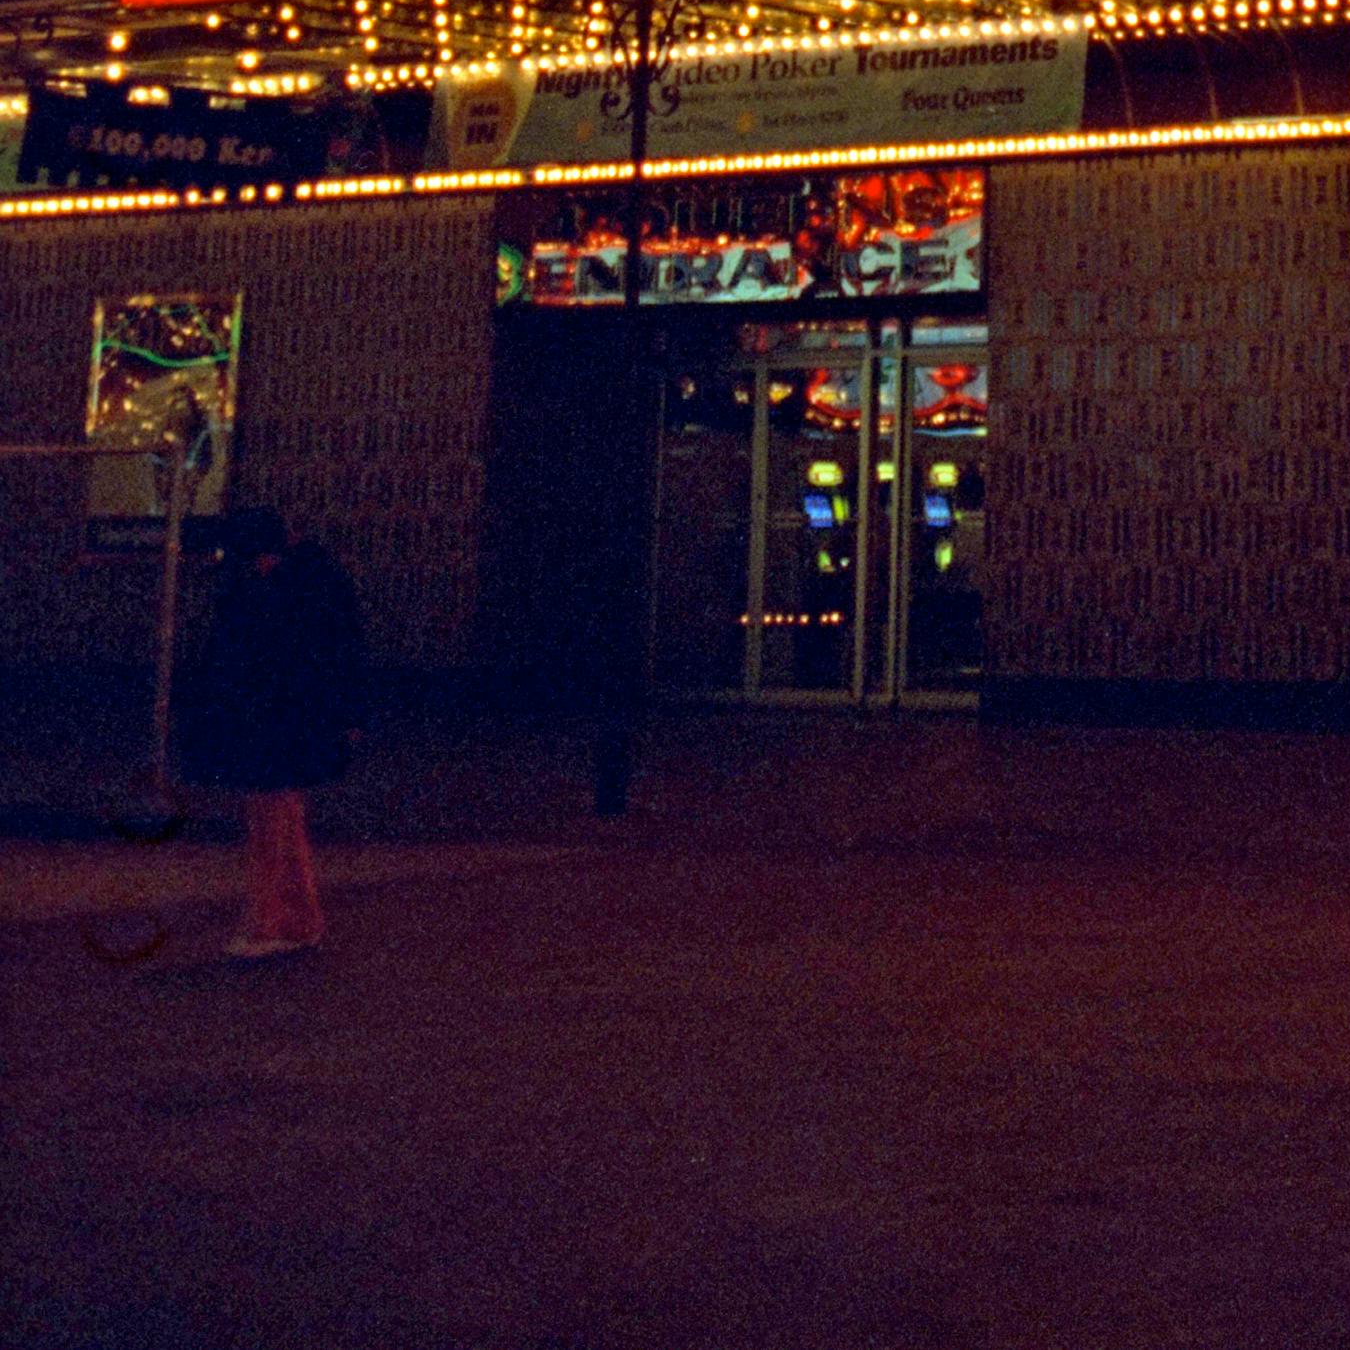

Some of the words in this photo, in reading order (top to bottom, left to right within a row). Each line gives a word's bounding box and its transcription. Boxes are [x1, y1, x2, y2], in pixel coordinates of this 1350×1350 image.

[750, 50, 842, 81] Poker
[853, 35, 1060, 76] Tournaments
[952, 85, 1026, 111] Queens
[533, 238, 951, 298] ENRACE
